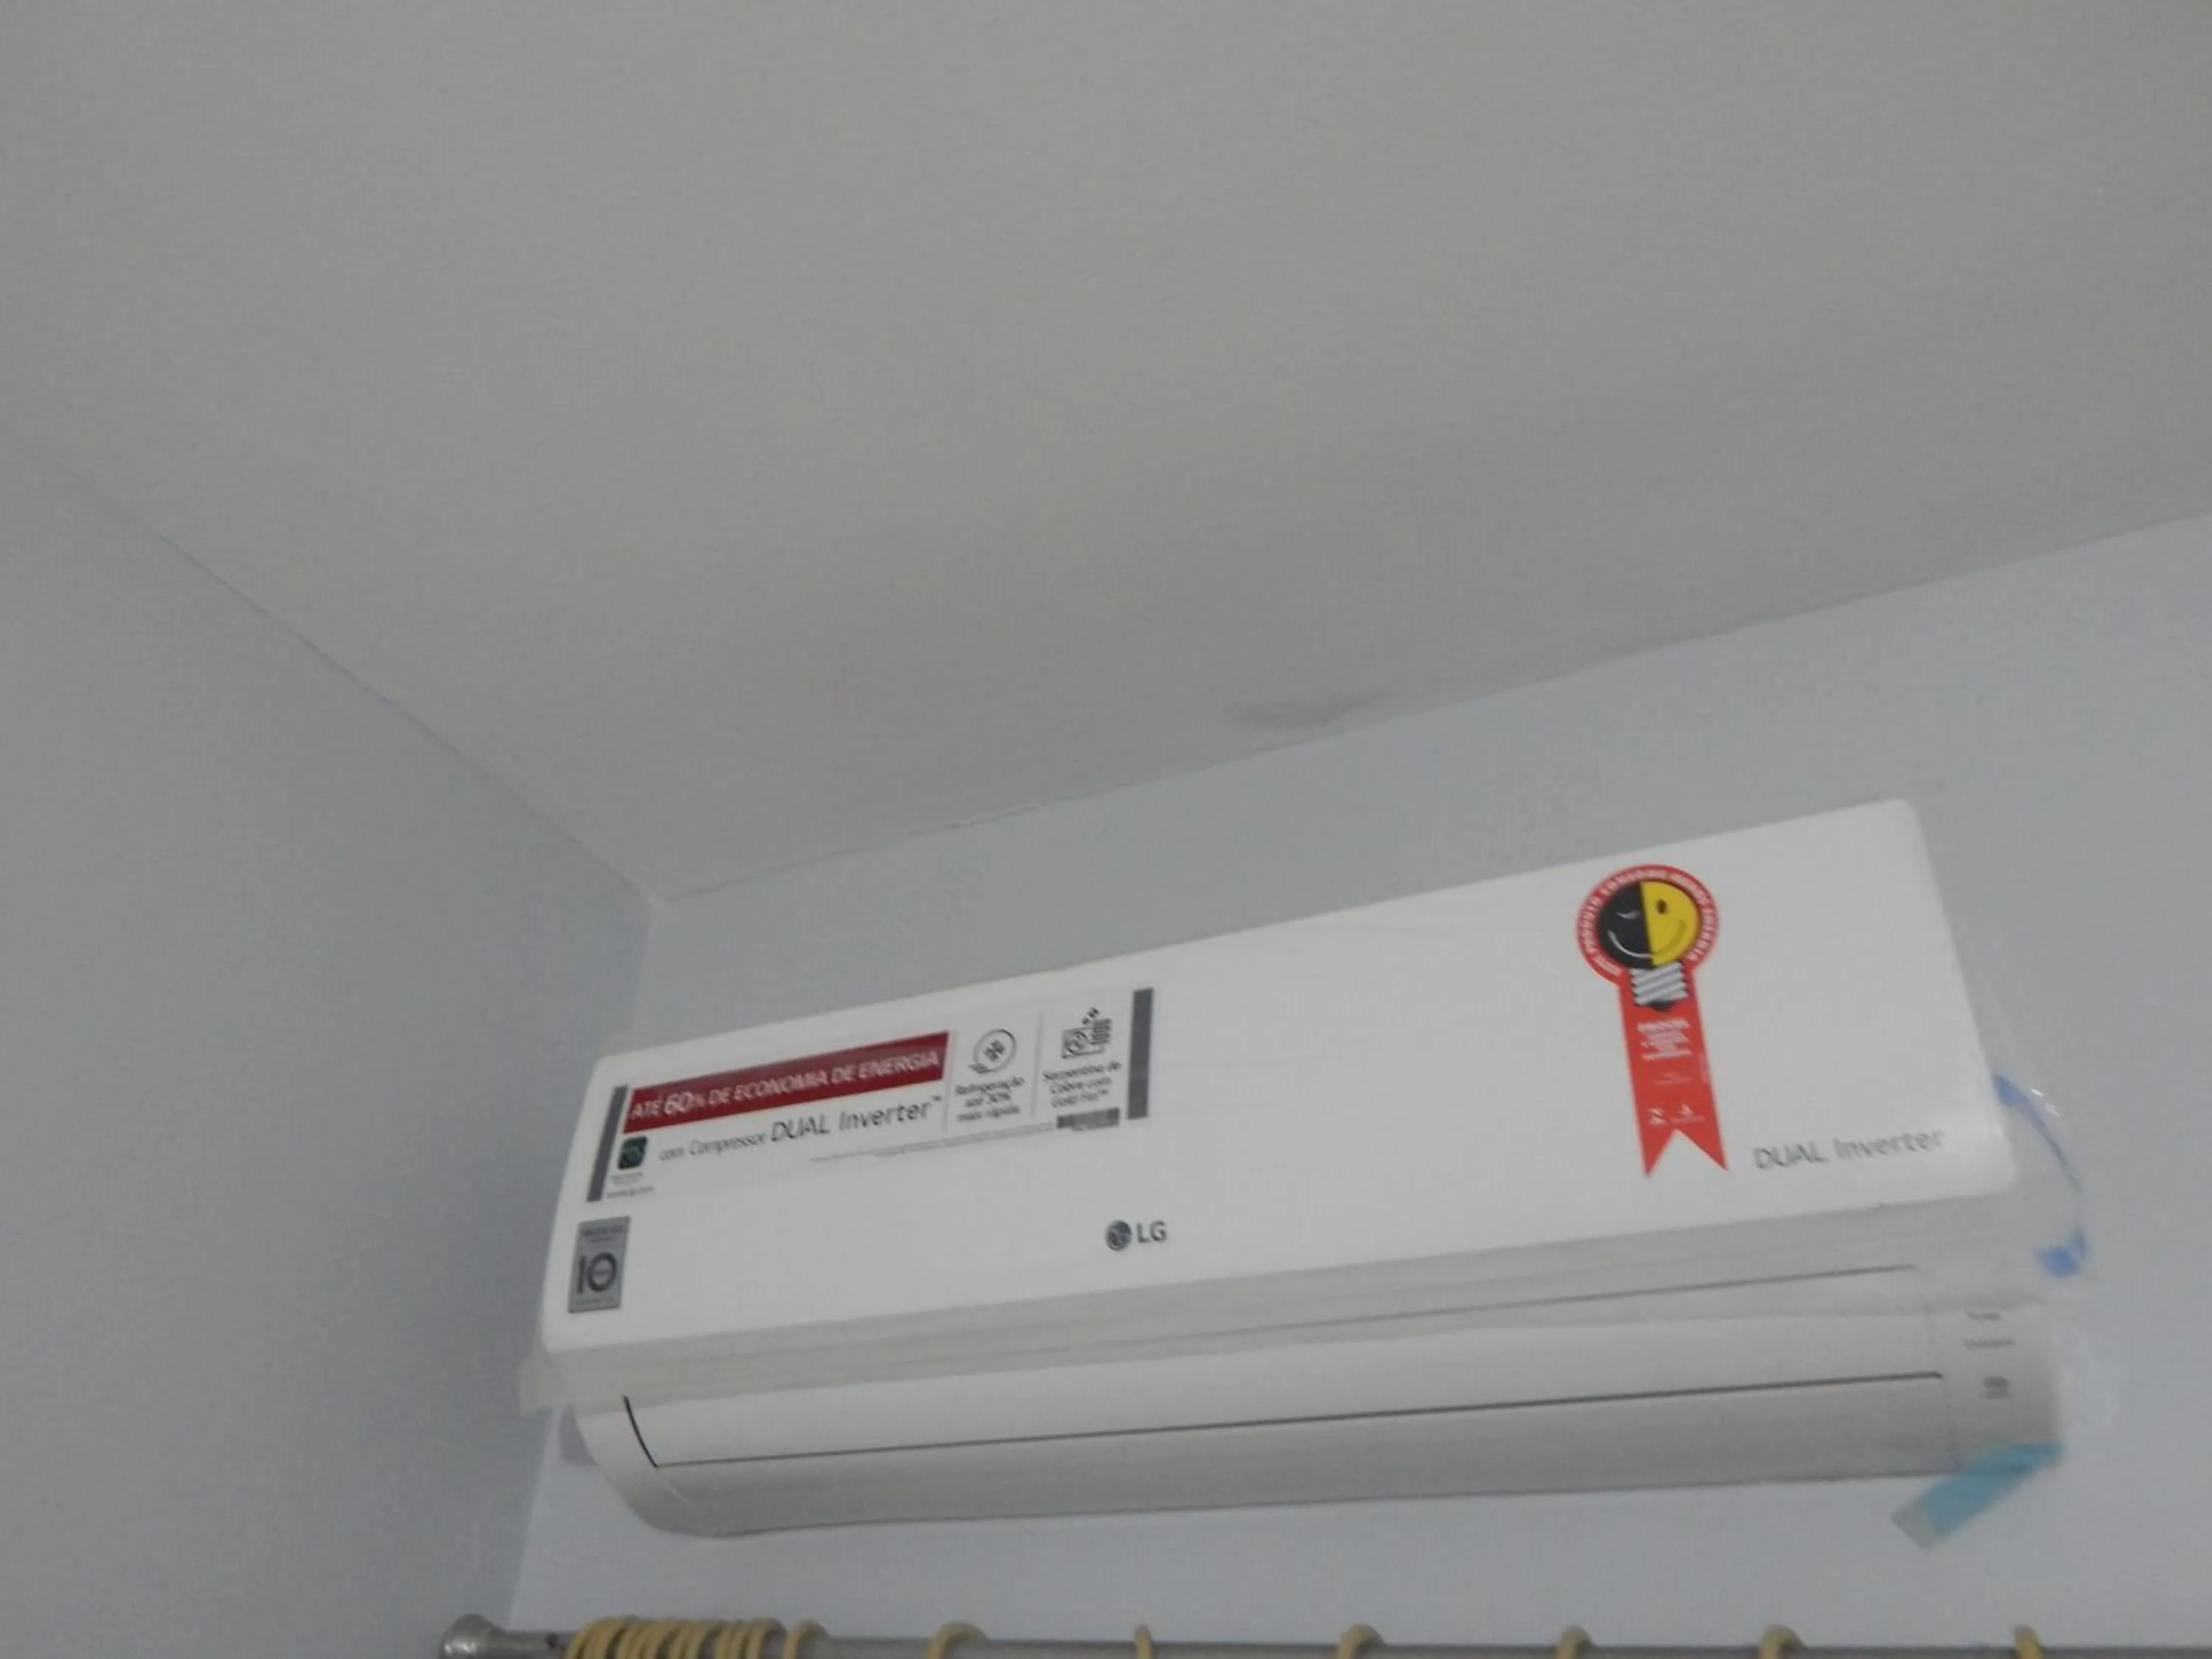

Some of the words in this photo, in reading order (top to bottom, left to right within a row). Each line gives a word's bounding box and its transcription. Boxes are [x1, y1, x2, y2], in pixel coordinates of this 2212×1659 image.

[708, 1086, 731, 1106] DE
[734, 1069, 829, 1102] ECONOMIA
[830, 1065, 858, 1085] DE
[858, 1050, 939, 1079] ENERGIA
[689, 1132, 768, 1156] Compressor
[771, 1116, 830, 1142] DUAL
[1753, 1141, 1830, 1169] DUAL
[1833, 1130, 1944, 1159] Inverter
[1136, 1220, 1167, 1243] LG
